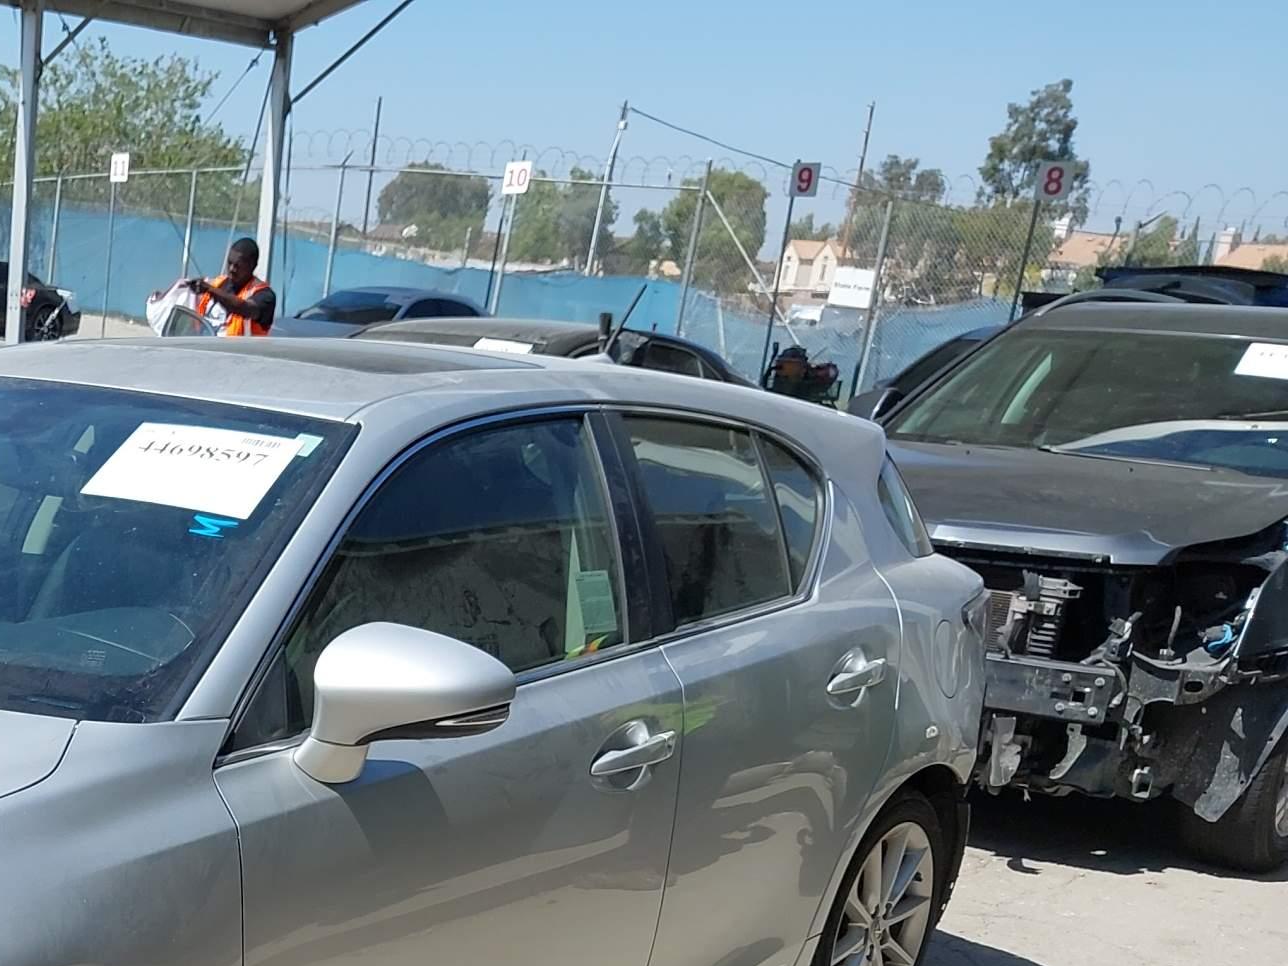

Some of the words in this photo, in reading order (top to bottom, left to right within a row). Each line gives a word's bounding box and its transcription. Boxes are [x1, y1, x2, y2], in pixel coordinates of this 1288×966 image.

[113, 160, 126, 177] 11
[505, 168, 528, 187] 10
[797, 167, 813, 193] 9
[1043, 166, 1065, 196] 8
[138, 440, 270, 466] 44698597
